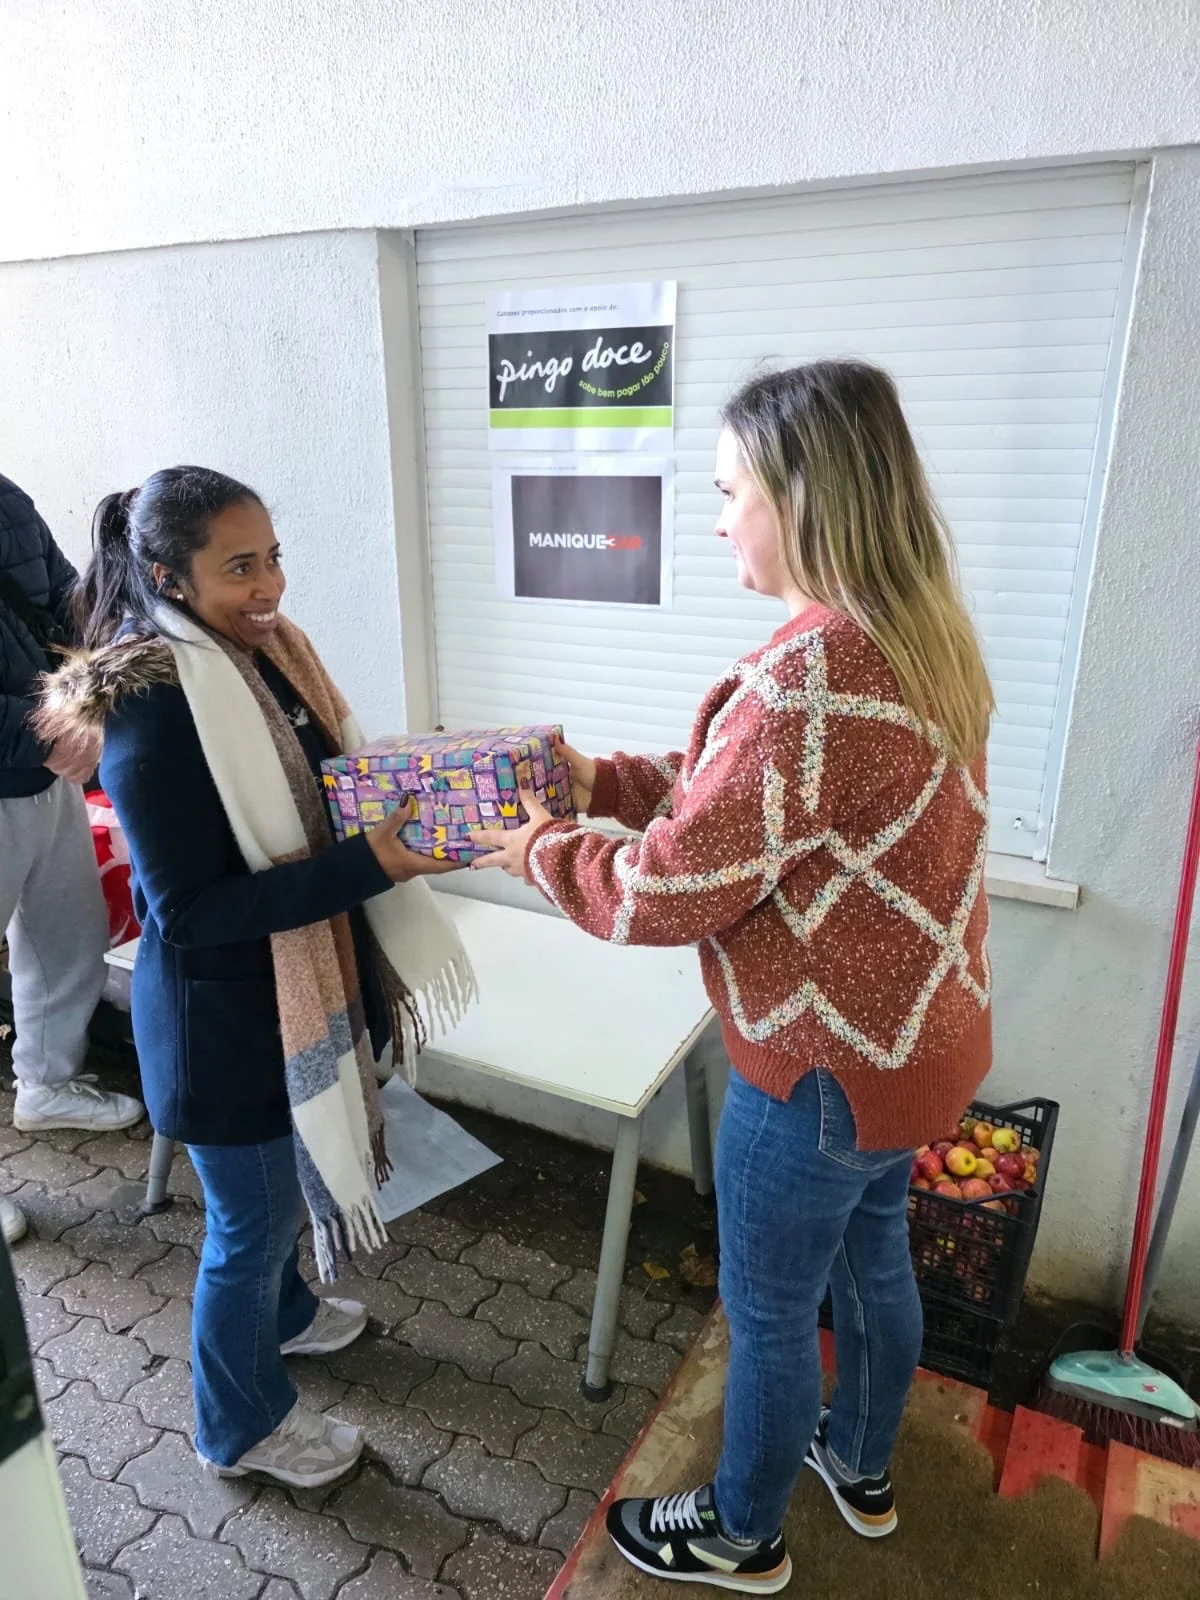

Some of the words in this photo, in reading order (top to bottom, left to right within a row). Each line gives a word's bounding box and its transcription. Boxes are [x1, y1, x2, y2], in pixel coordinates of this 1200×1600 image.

[496, 350, 573, 402] pingo
[581, 336, 652, 372] doce
[579, 379, 597, 394] sabe
[598, 387, 615, 398] bem
[617, 383, 641, 399] pagar
[641, 372, 655, 388] tão
[654, 341, 670, 375] pouco
